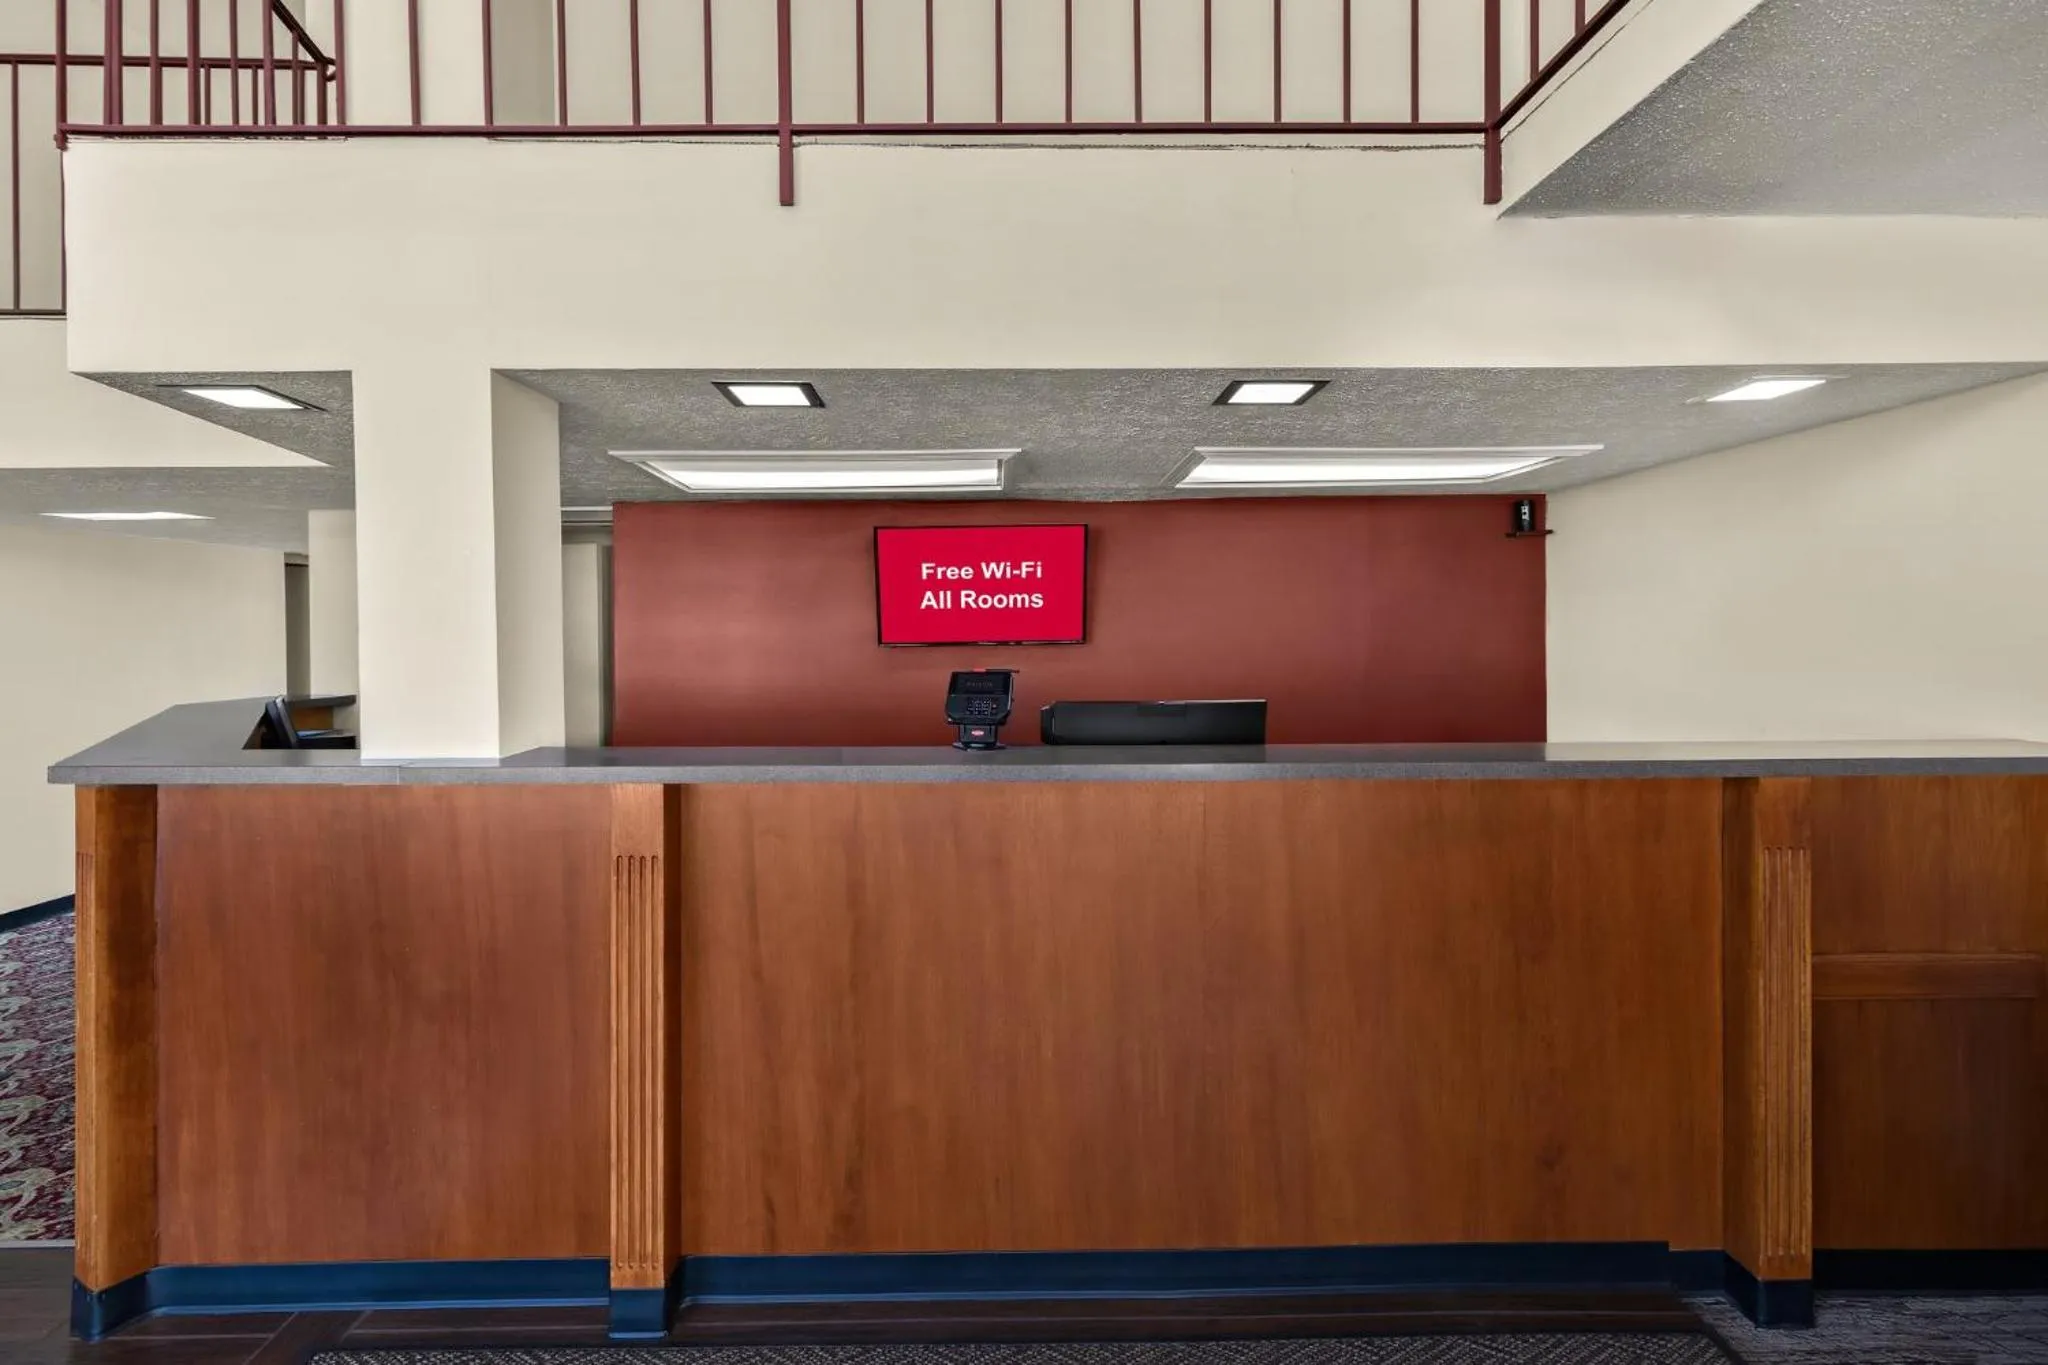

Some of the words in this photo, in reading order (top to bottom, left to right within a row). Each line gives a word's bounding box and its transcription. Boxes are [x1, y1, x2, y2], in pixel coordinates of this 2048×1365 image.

[921, 562, 974, 580] Free
[981, 561, 1043, 579] Wi-Fi
[920, 590, 952, 609] All
[960, 589, 1044, 609] Rooms
